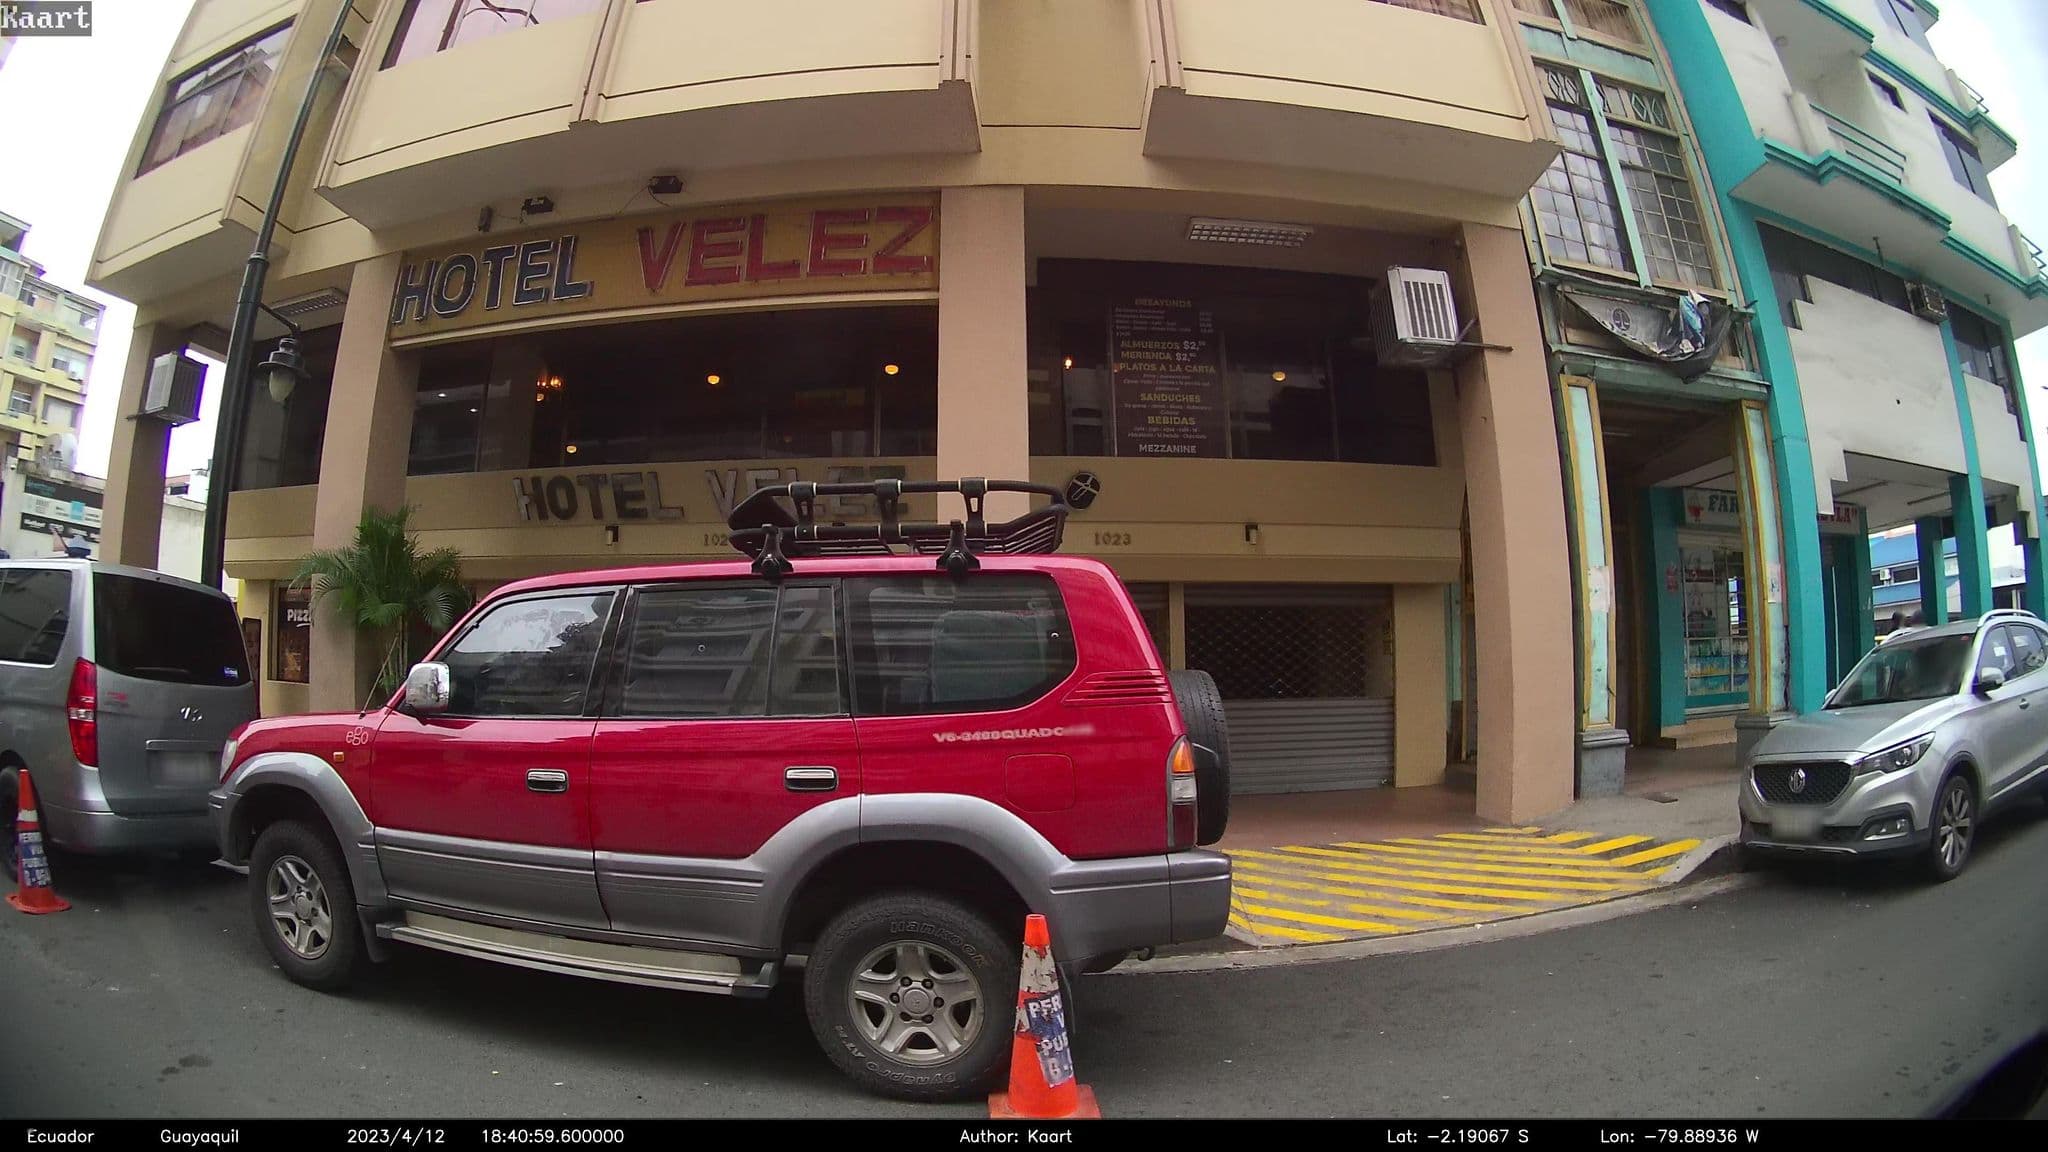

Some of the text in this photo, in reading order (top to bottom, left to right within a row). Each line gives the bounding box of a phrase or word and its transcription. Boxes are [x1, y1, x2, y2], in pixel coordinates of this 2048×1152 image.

[391, 206, 934, 325] HOTEL VELEZ
[1120, 340, 1181, 350] ALMUERZOS
[1120, 351, 1173, 361] MERIENDA
[1119, 363, 1216, 374] PLATOS A LA CARTA
[1140, 393, 1201, 403] SANDUCHES
[1147, 415, 1197, 426] BEBIDAS
[1139, 444, 1197, 454] MEZZANINE
[512, 471, 685, 522] HOTEL
[703, 533, 729, 547] 102
[1094, 532, 1132, 546] 1023
[345, 726, 369, 746] ego
